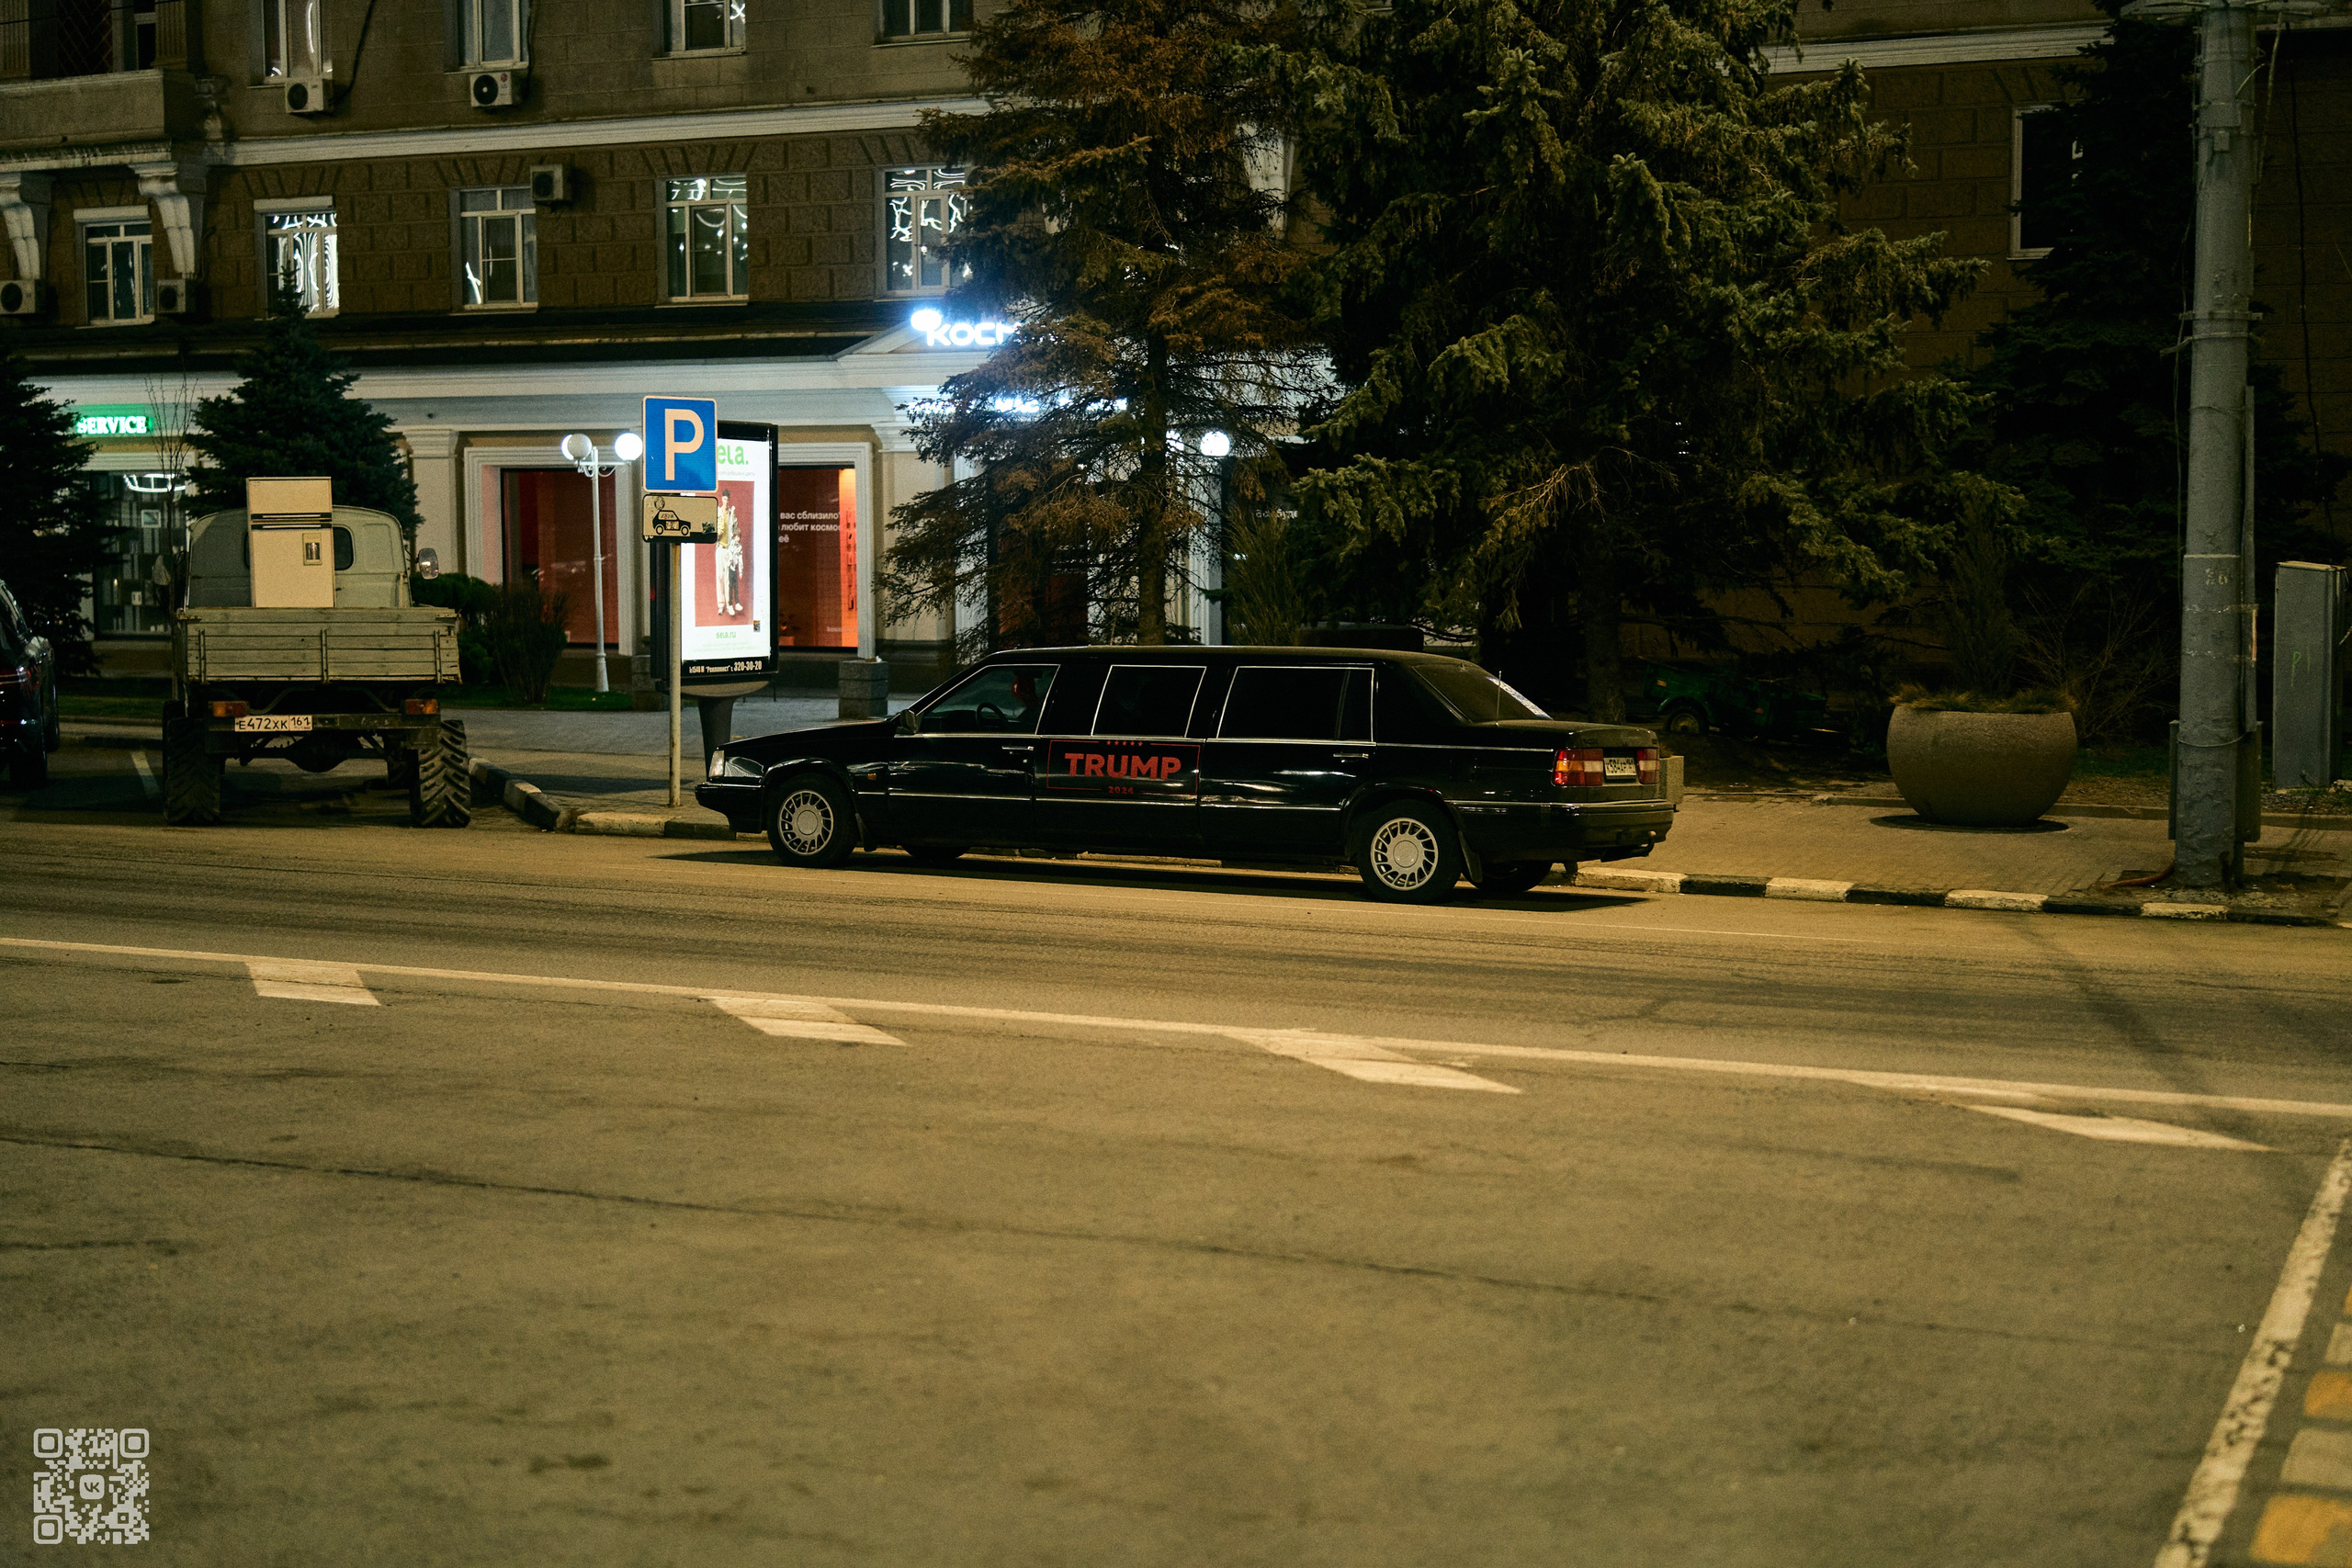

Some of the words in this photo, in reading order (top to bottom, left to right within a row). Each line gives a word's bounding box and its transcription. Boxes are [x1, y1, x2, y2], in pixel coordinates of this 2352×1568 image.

[76, 416, 147, 434] SERVICE
[664, 408, 705, 481] P
[717, 445, 749, 466] ela.
[781, 523, 809, 531] любит
[716, 631, 737, 639] sela.ru
[734, 660, 763, 671] 320-30-20
[239, 717, 288, 730] Е472ХК
[290, 716, 311, 726] 161
[1064, 752, 1182, 780] TRUMP
[1108, 785, 1135, 795] 2024
